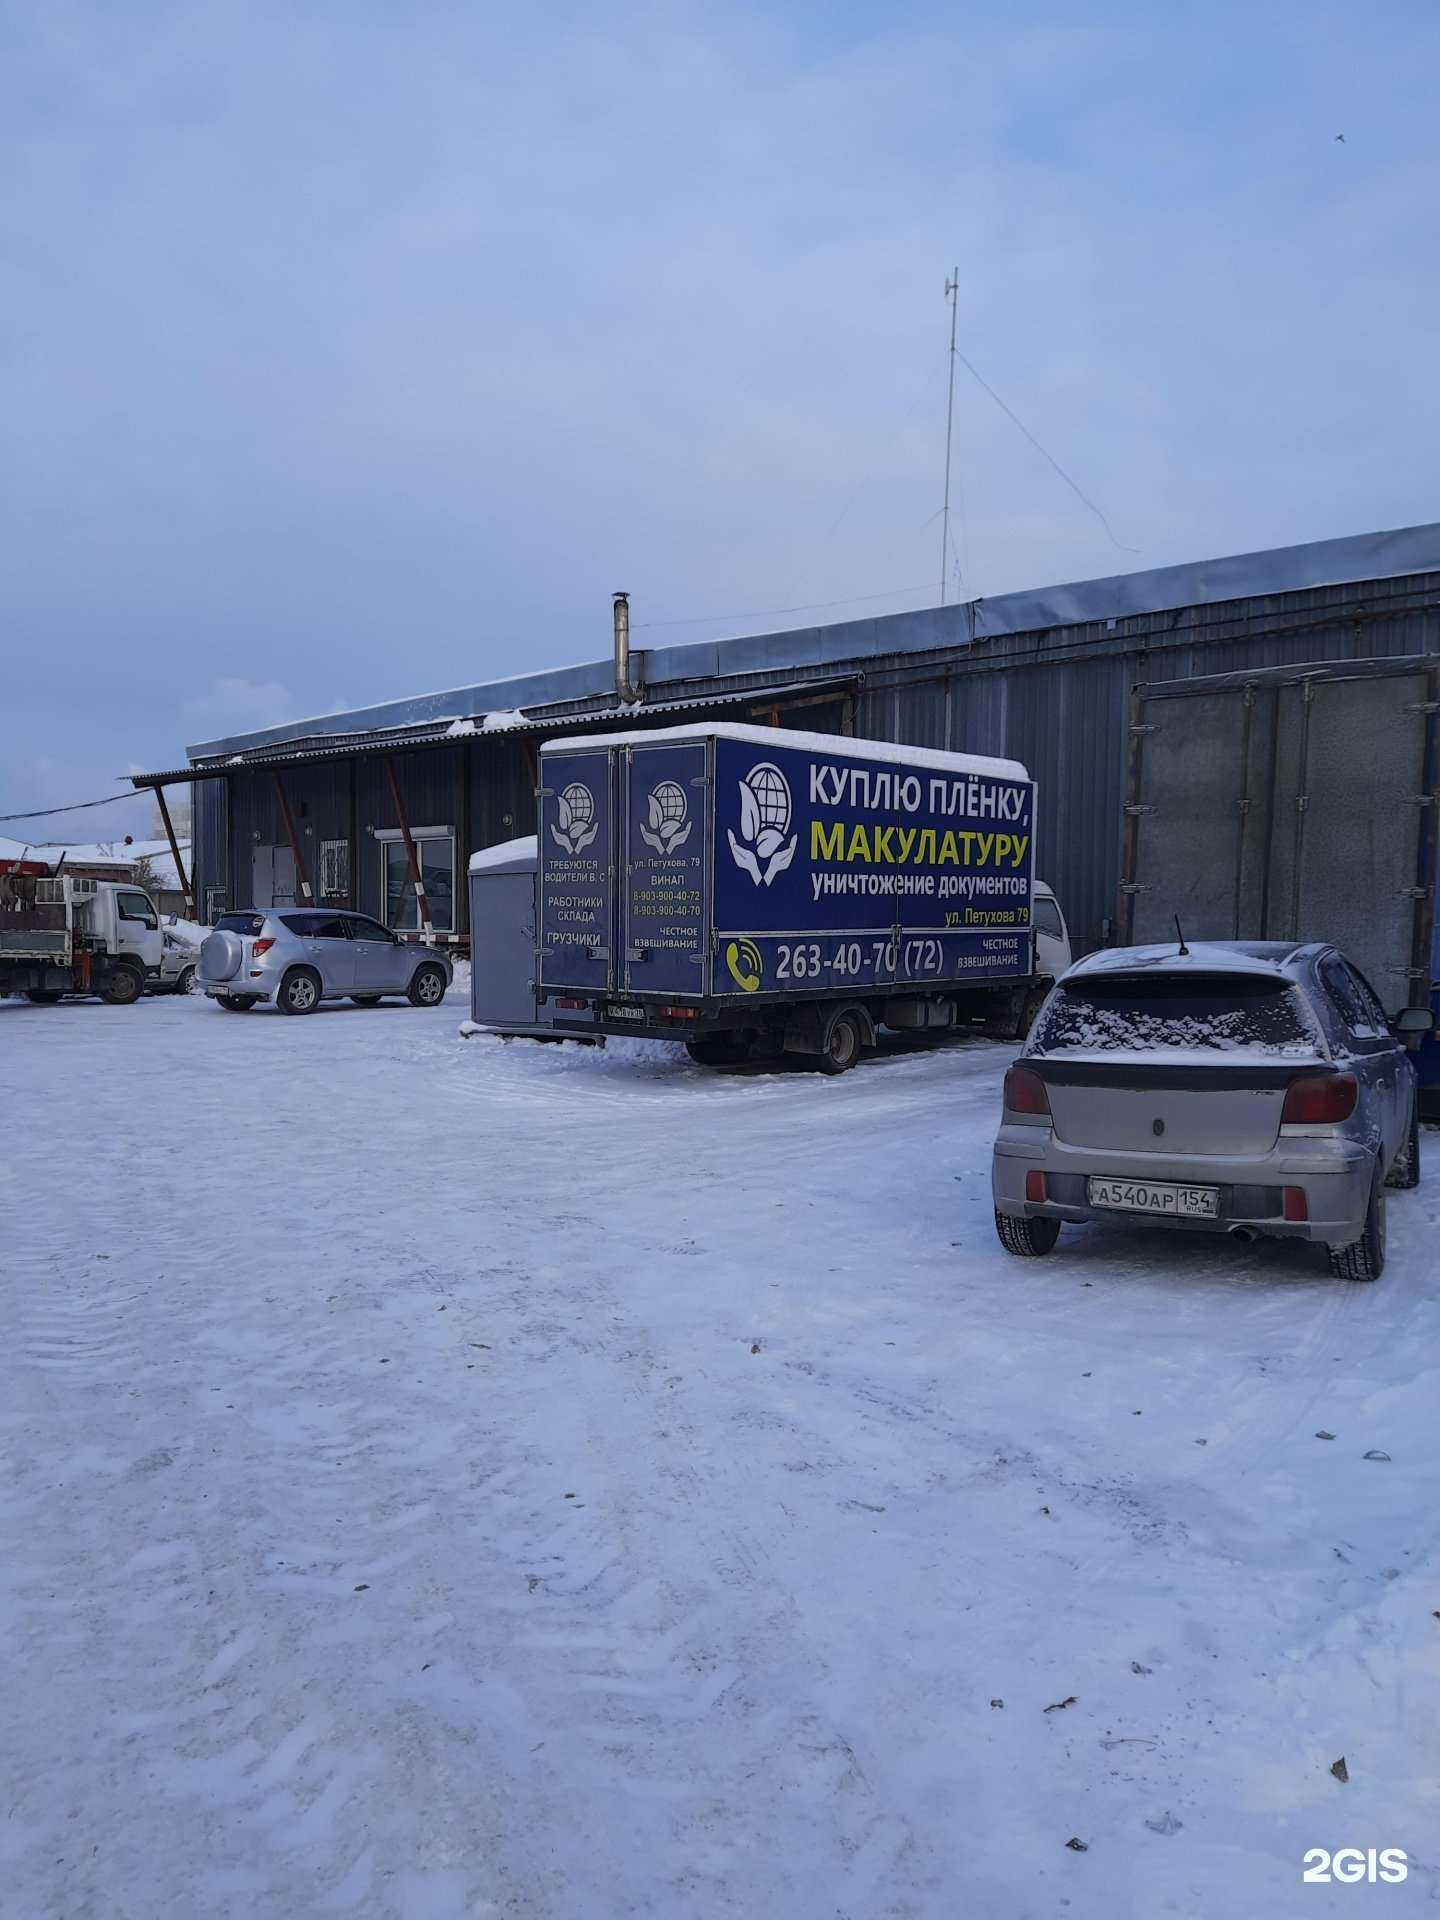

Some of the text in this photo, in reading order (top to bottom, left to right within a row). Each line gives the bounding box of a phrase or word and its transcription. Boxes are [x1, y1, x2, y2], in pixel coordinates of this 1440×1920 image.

[810, 764, 1029, 826] КУПЛЮ ПЛЁНКУ,
[810, 820, 1029, 868] МАКУЛАТУРУ
[550, 860, 598, 870] ТРЕБУЮТСЯ
[690, 857, 700, 867] 79
[544, 872, 588, 882] ВОДИТЕЛИ
[651, 875, 685, 886] ВИНАП
[811, 872, 1028, 901] уничтожение документов
[633, 890, 700, 901] 8-903-900-40-72
[548, 896, 603, 908] РАБОТНИКИ
[557, 910, 595, 923] СКЛАДА
[633, 905, 701, 916] 8-903-900-40-70
[945, 907, 1029, 928] ул. Петухова 79
[660, 927, 698, 936] ЧЕСТНОЕ
[547, 932, 601, 946] ГРУЗЧИКИ
[634, 938, 698, 948] ВЗВЕШИВАНИЕ
[983, 938, 1019, 950] ЧЕСТНОЕ
[776, 939, 944, 979] 263-40-70 (72)
[958, 954, 1019, 969] ВЗВЕШИВАНИЕ
[1180, 1190, 1210, 1207] 154
